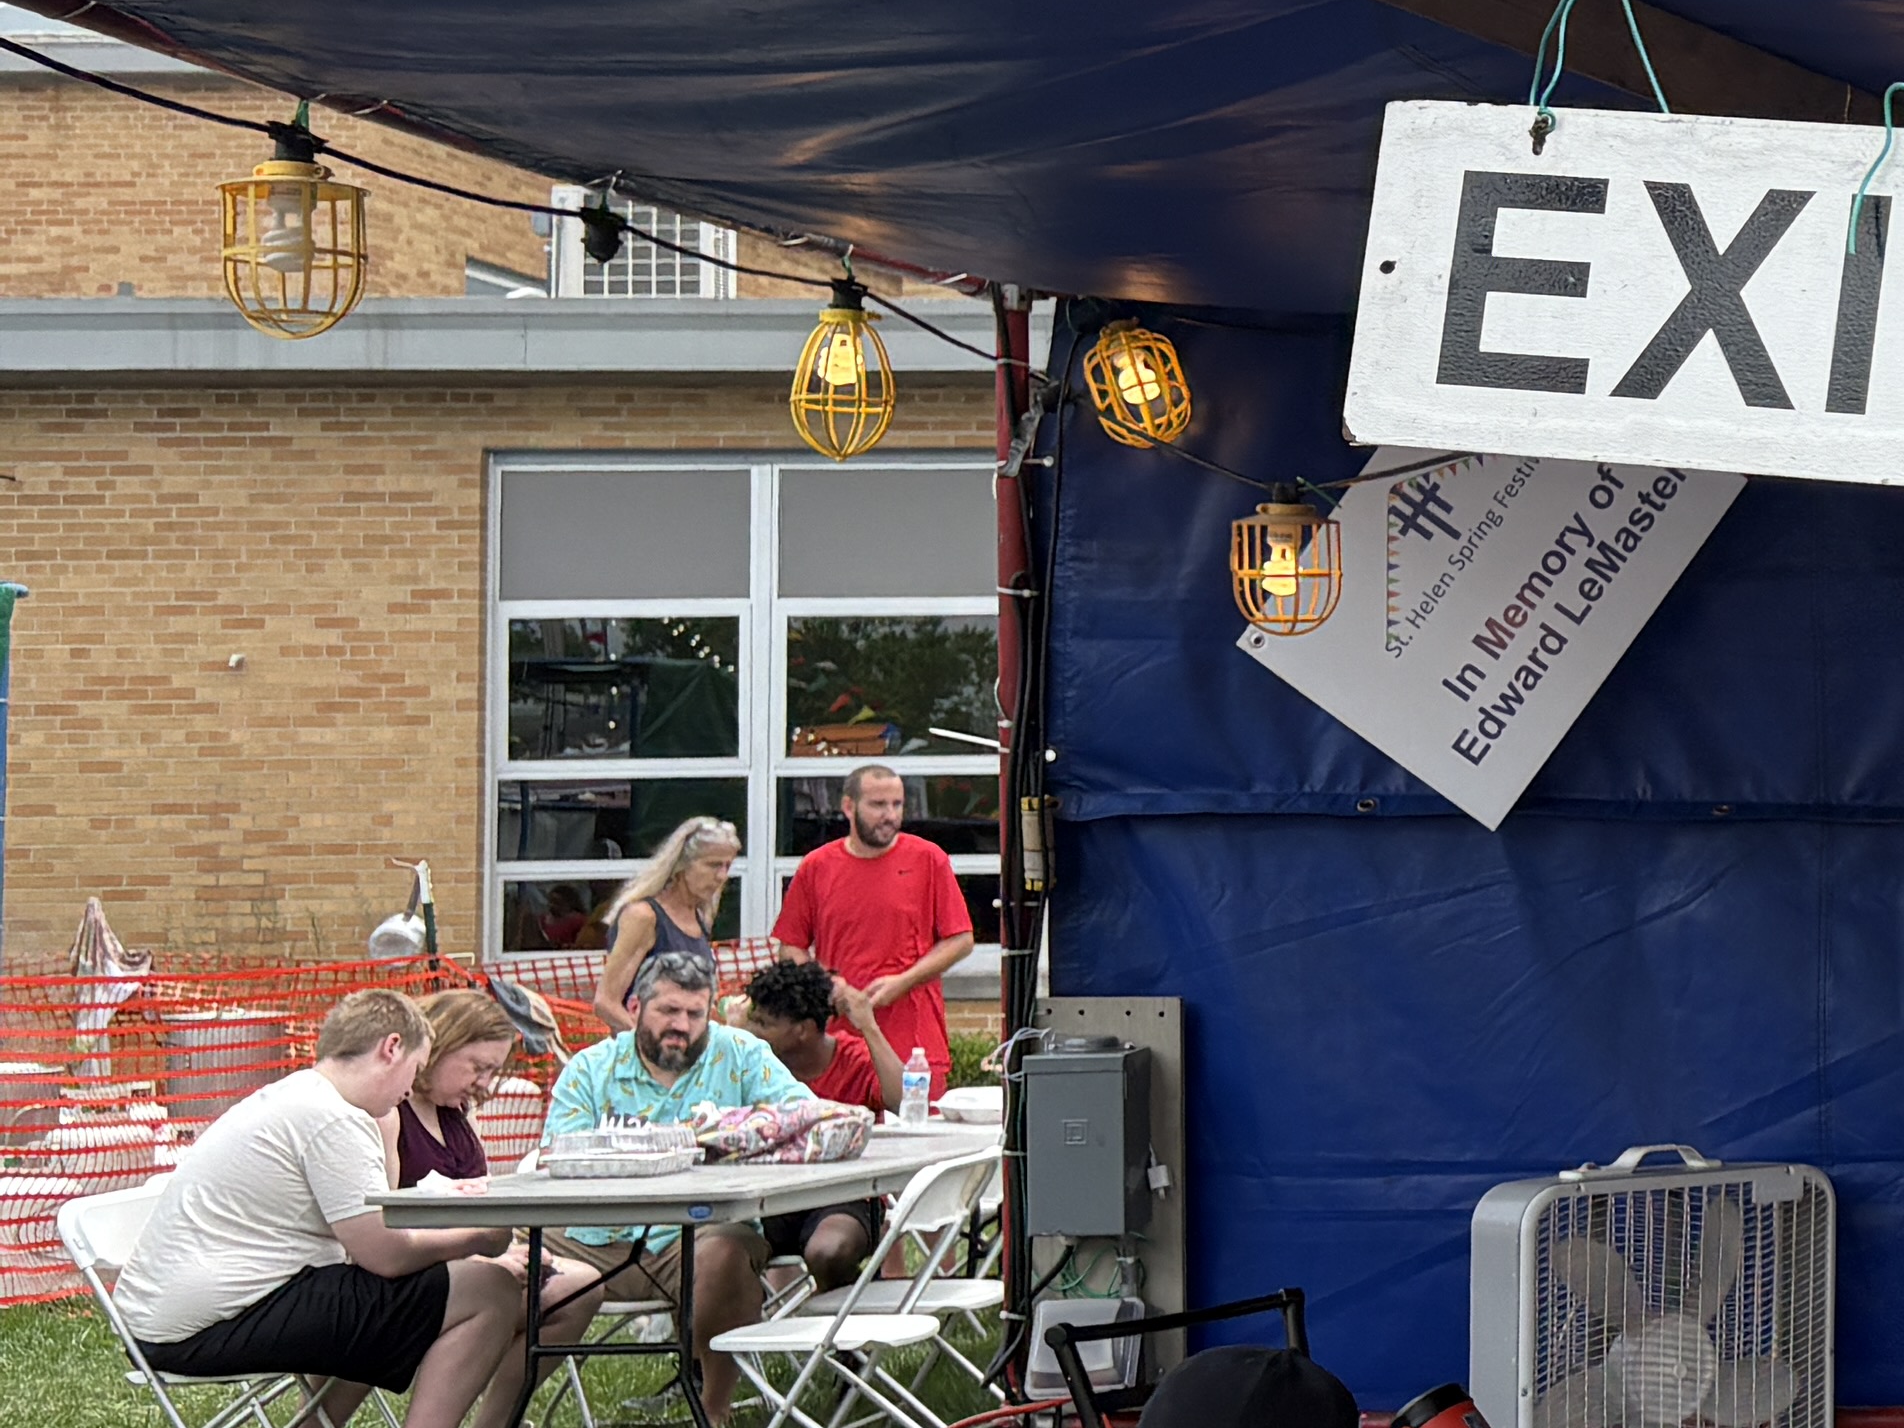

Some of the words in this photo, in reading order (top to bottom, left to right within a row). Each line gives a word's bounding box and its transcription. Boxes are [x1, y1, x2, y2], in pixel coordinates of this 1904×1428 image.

[1385, 632, 1414, 658] St.
[1405, 571, 1455, 629] Helen
[1448, 508, 1504, 572] Spring
[1493, 457, 1539, 508] Festi
[1441, 662, 1487, 702] In
[1471, 511, 1595, 660] Memory
[1588, 462, 1625, 510] of
[1451, 622, 1568, 766] Edward
